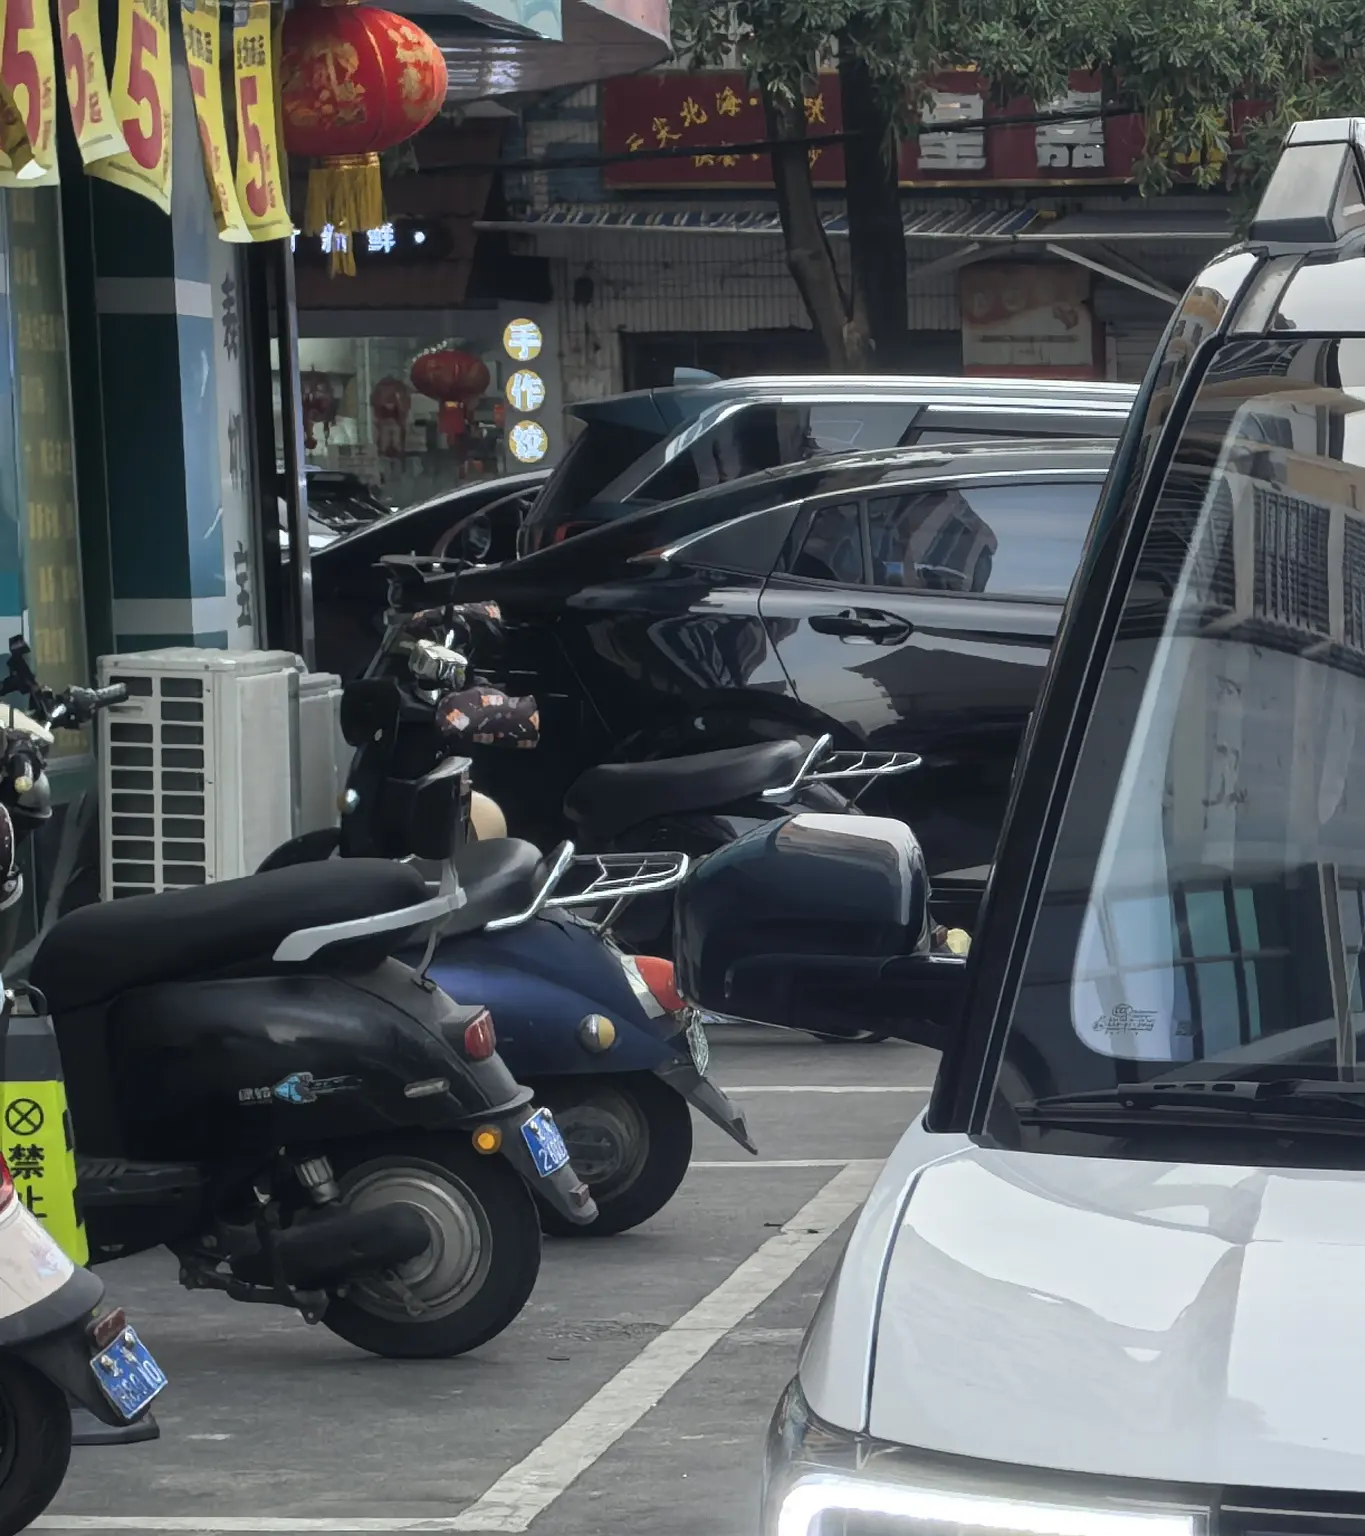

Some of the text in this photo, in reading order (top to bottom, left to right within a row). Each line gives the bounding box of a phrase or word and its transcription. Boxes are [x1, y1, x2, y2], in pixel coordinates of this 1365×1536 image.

[122, 11, 163, 170] 5
[240, 75, 269, 217] 5
[8, 1143, 48, 1219] 禁止
